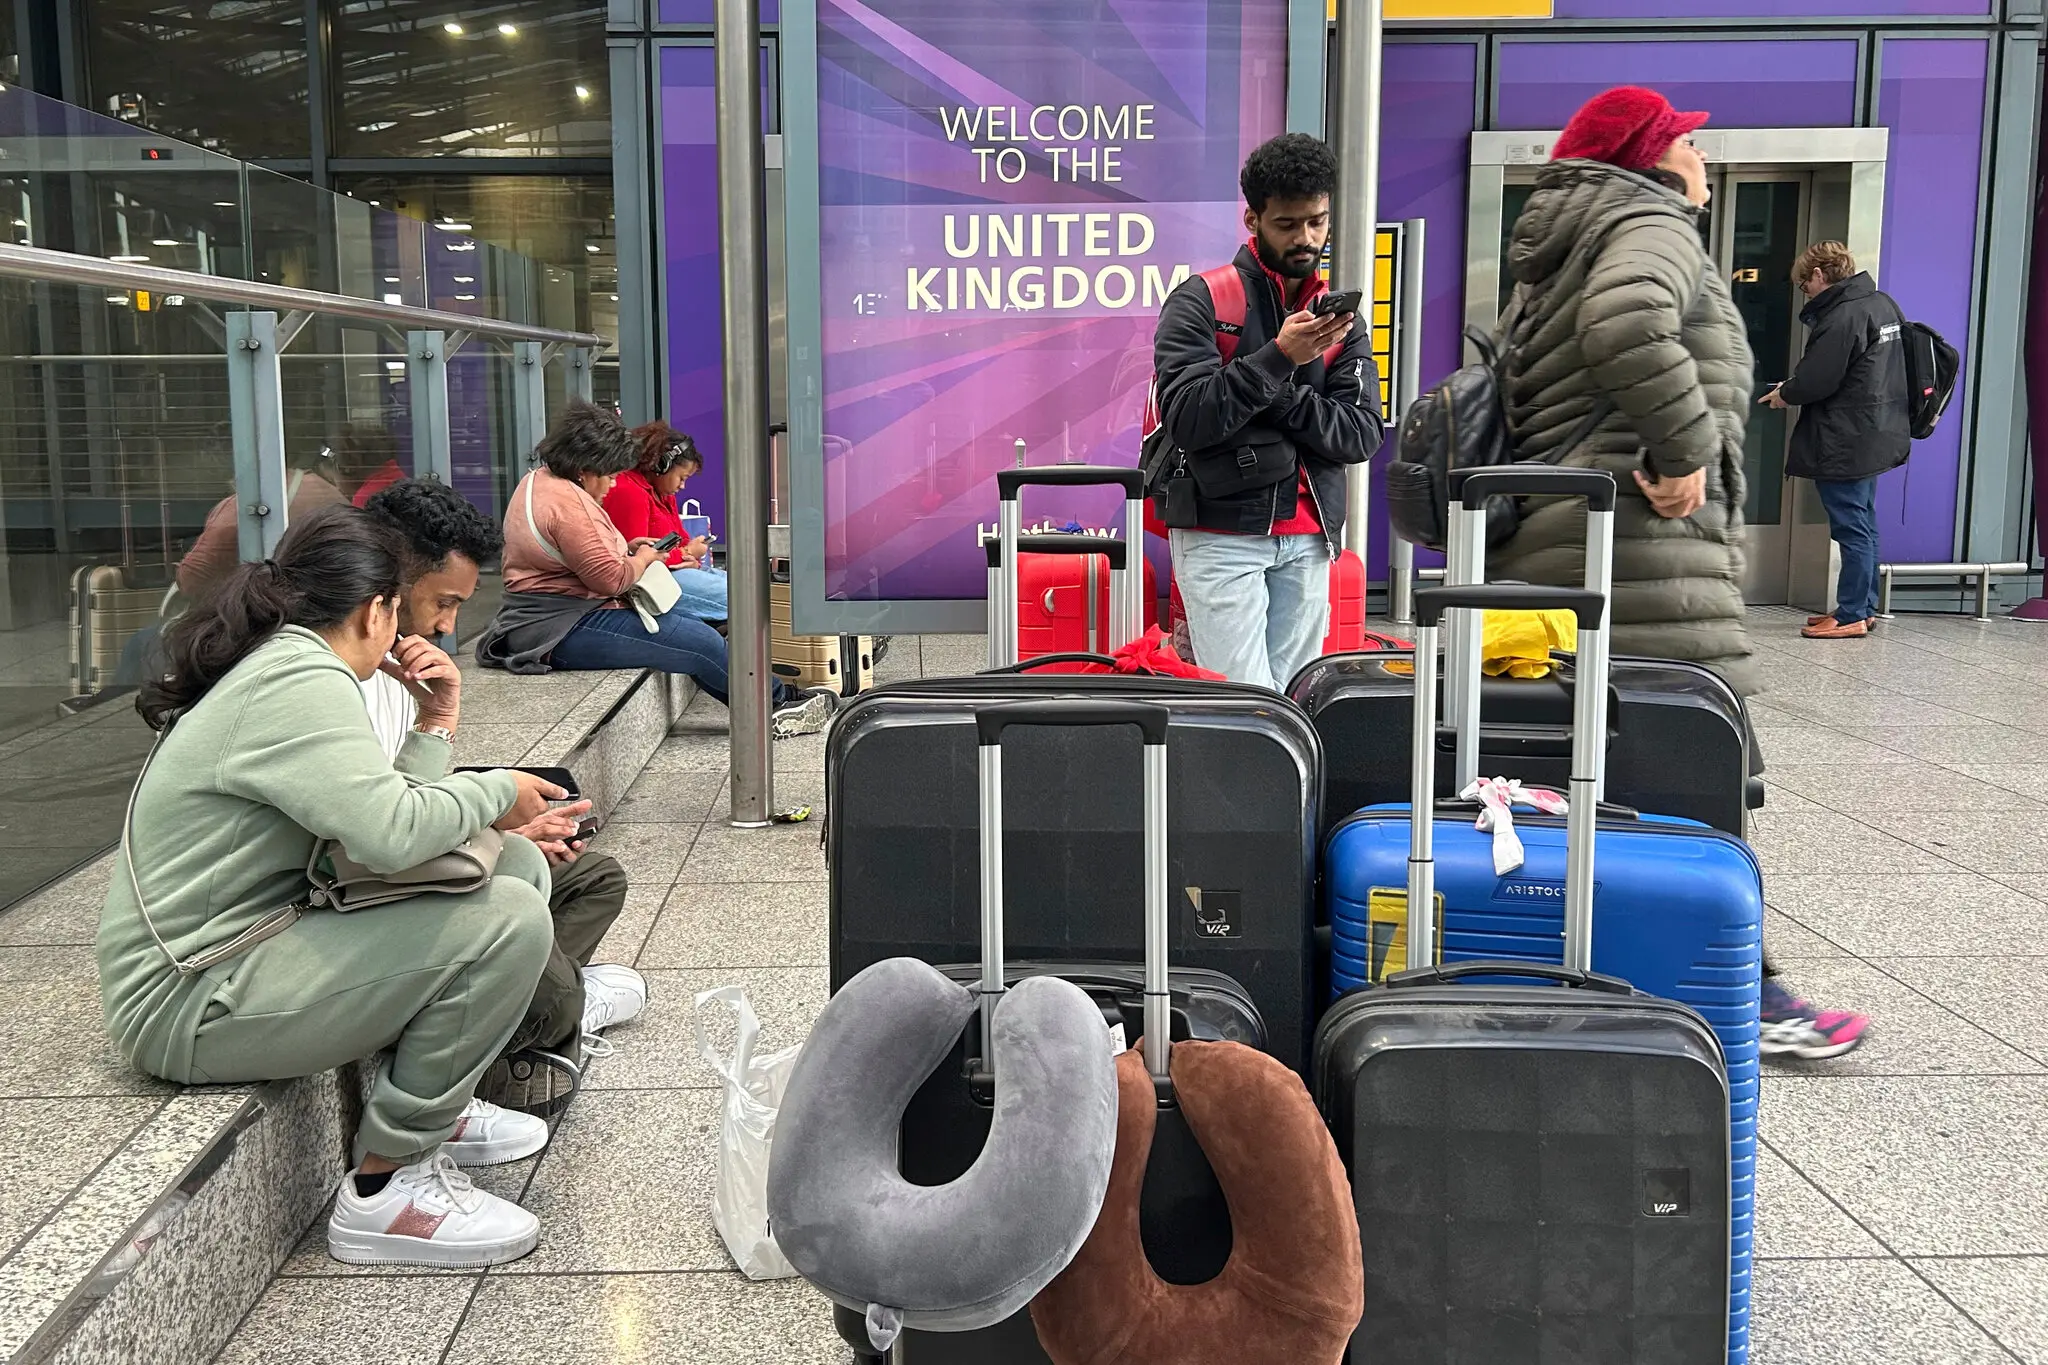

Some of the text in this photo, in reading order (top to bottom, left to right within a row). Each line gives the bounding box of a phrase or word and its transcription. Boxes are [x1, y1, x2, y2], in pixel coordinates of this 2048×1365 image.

[940, 104, 1155, 142] WELCOME
[971, 147, 1122, 183] TO THE
[944, 213, 1155, 259] UNITED
[907, 264, 1190, 313] KINGDOM
[1653, 1203, 1678, 1213] VIP
